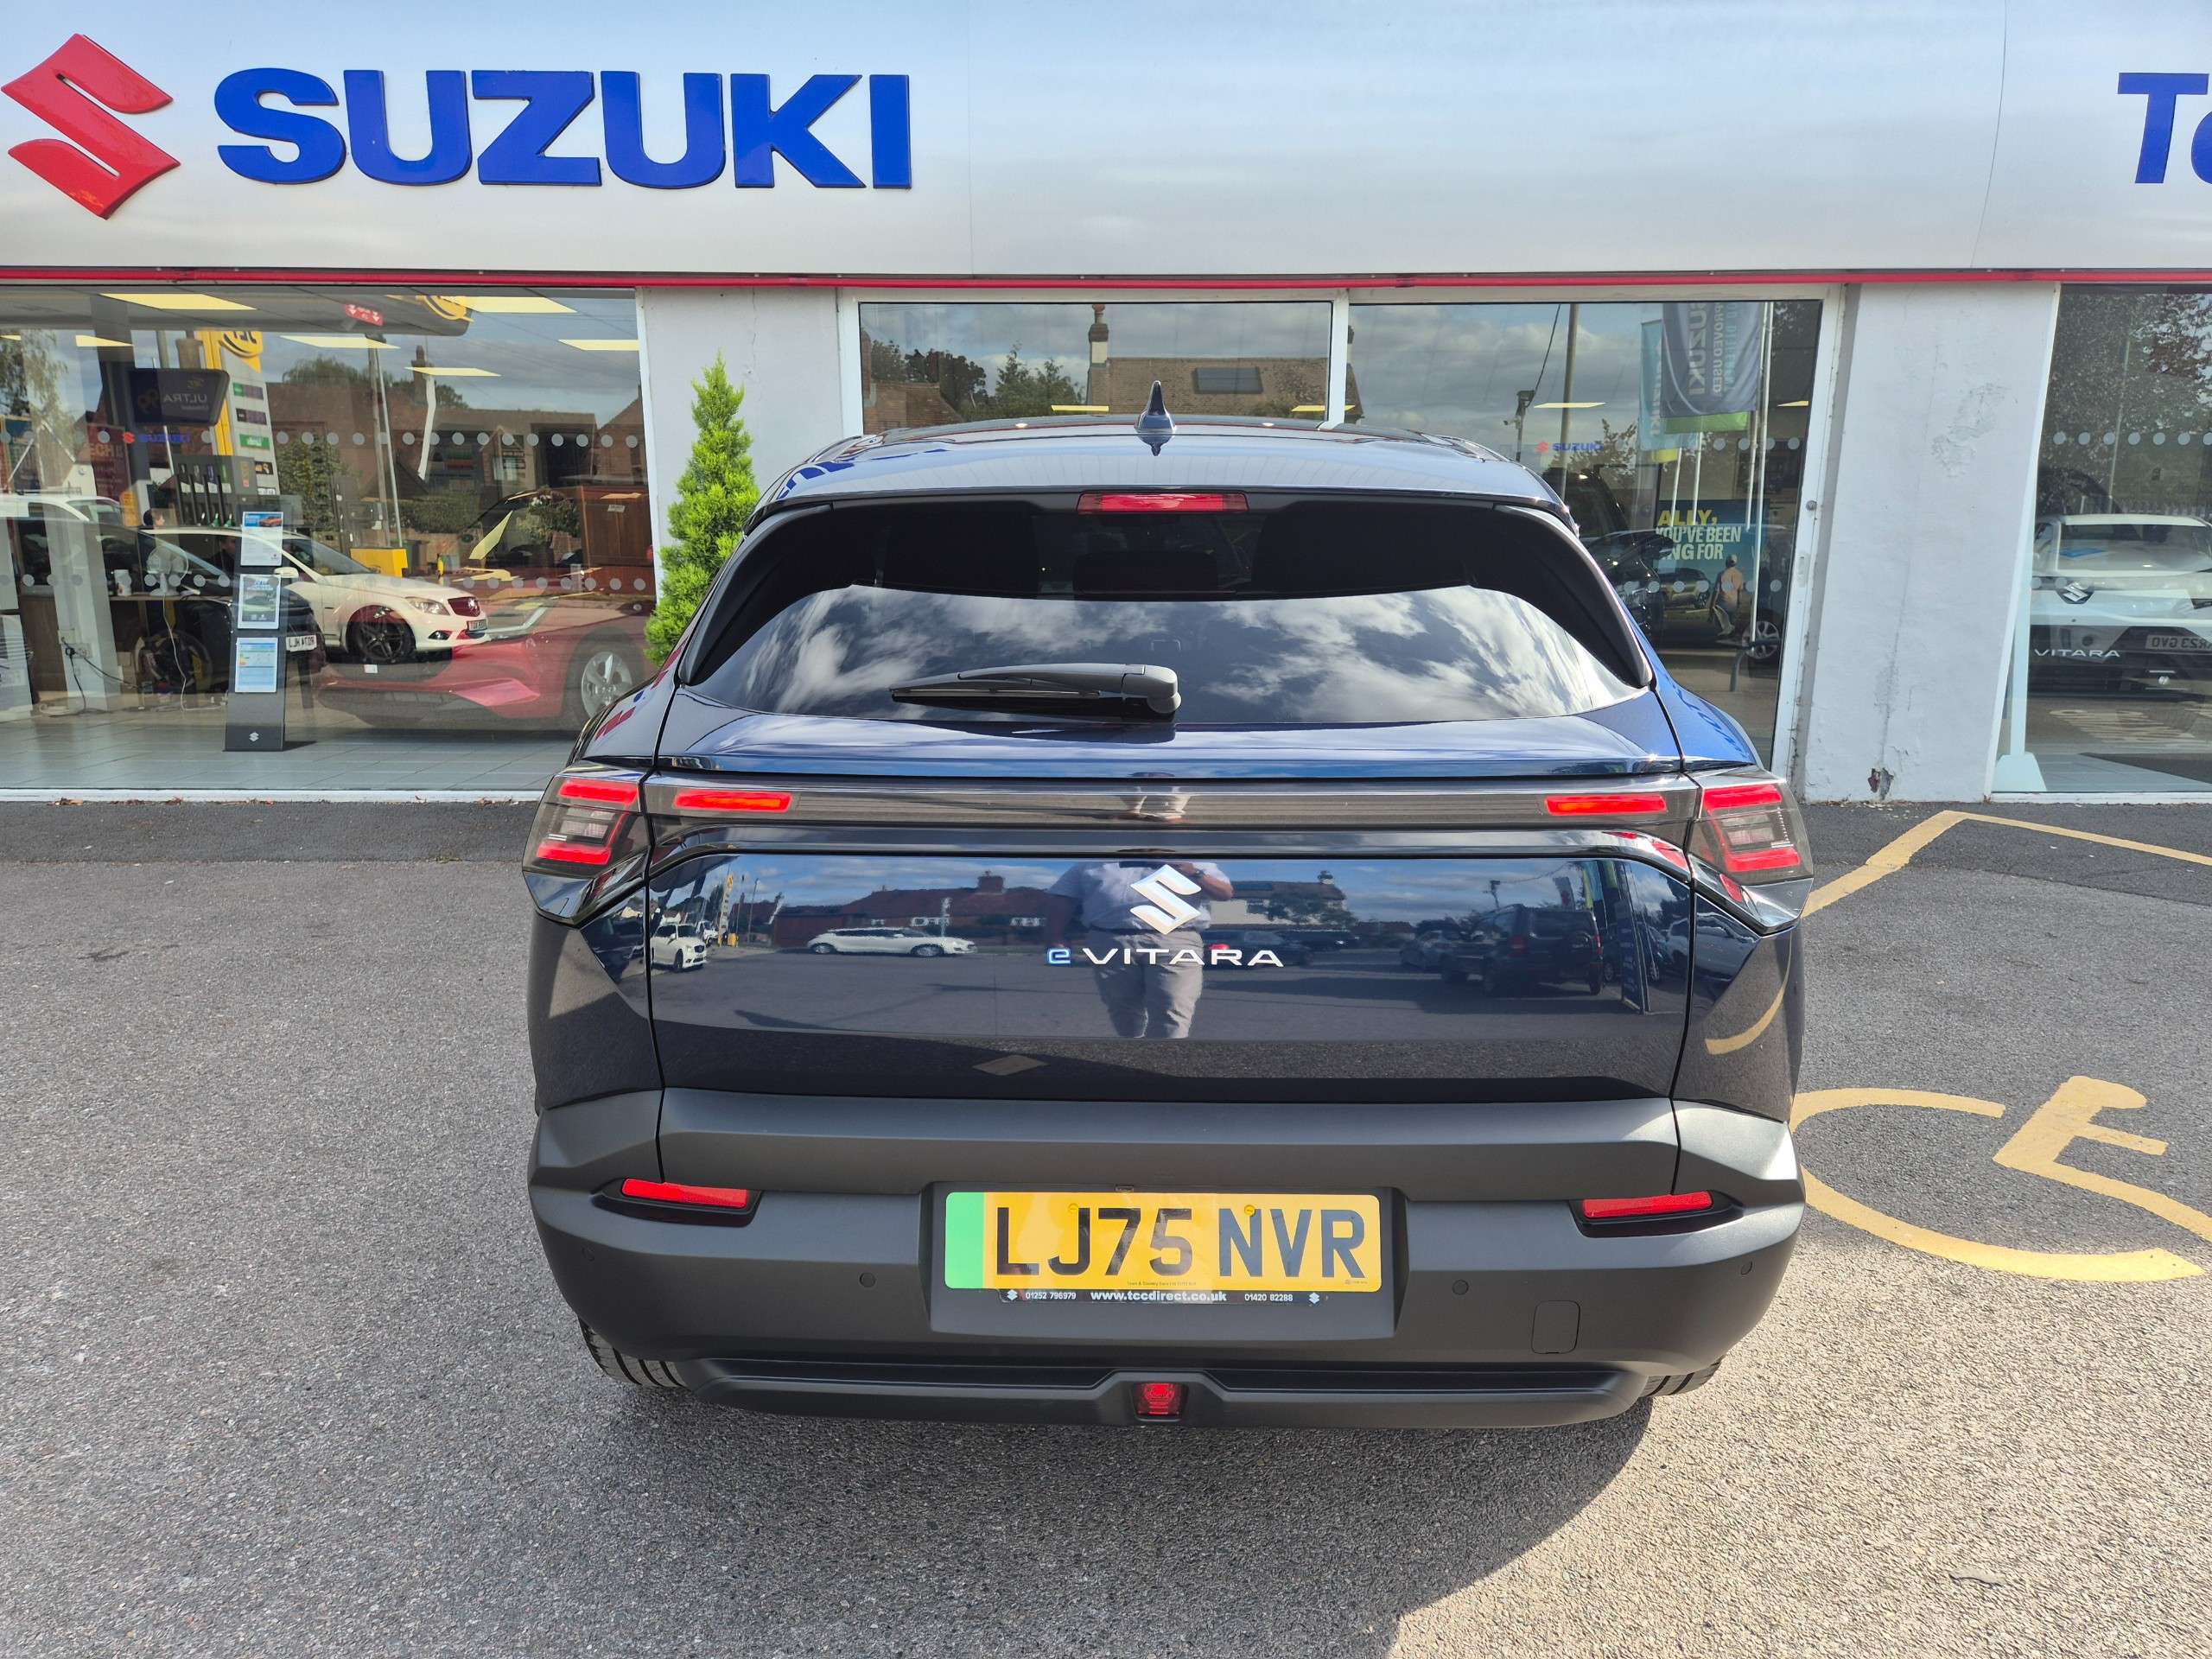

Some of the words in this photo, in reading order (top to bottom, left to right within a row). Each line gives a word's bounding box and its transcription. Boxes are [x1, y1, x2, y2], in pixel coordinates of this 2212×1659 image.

[213, 67, 911, 189] SUZUKI
[2117, 73, 2212, 184] T
[1707, 525, 1742, 543] BEEN
[1670, 543, 1694, 560] NG
[1697, 543, 1724, 560] FOR
[2034, 649, 2120, 658] VITARA
[1082, 947, 1284, 968] VITARA
[996, 1206, 1193, 1276] LJ75
[1219, 1207, 1365, 1279] NVR
[1090, 1290, 1227, 1302] www.tccdirect.co.uk
[1244, 1293, 1267, 1301] 01420
